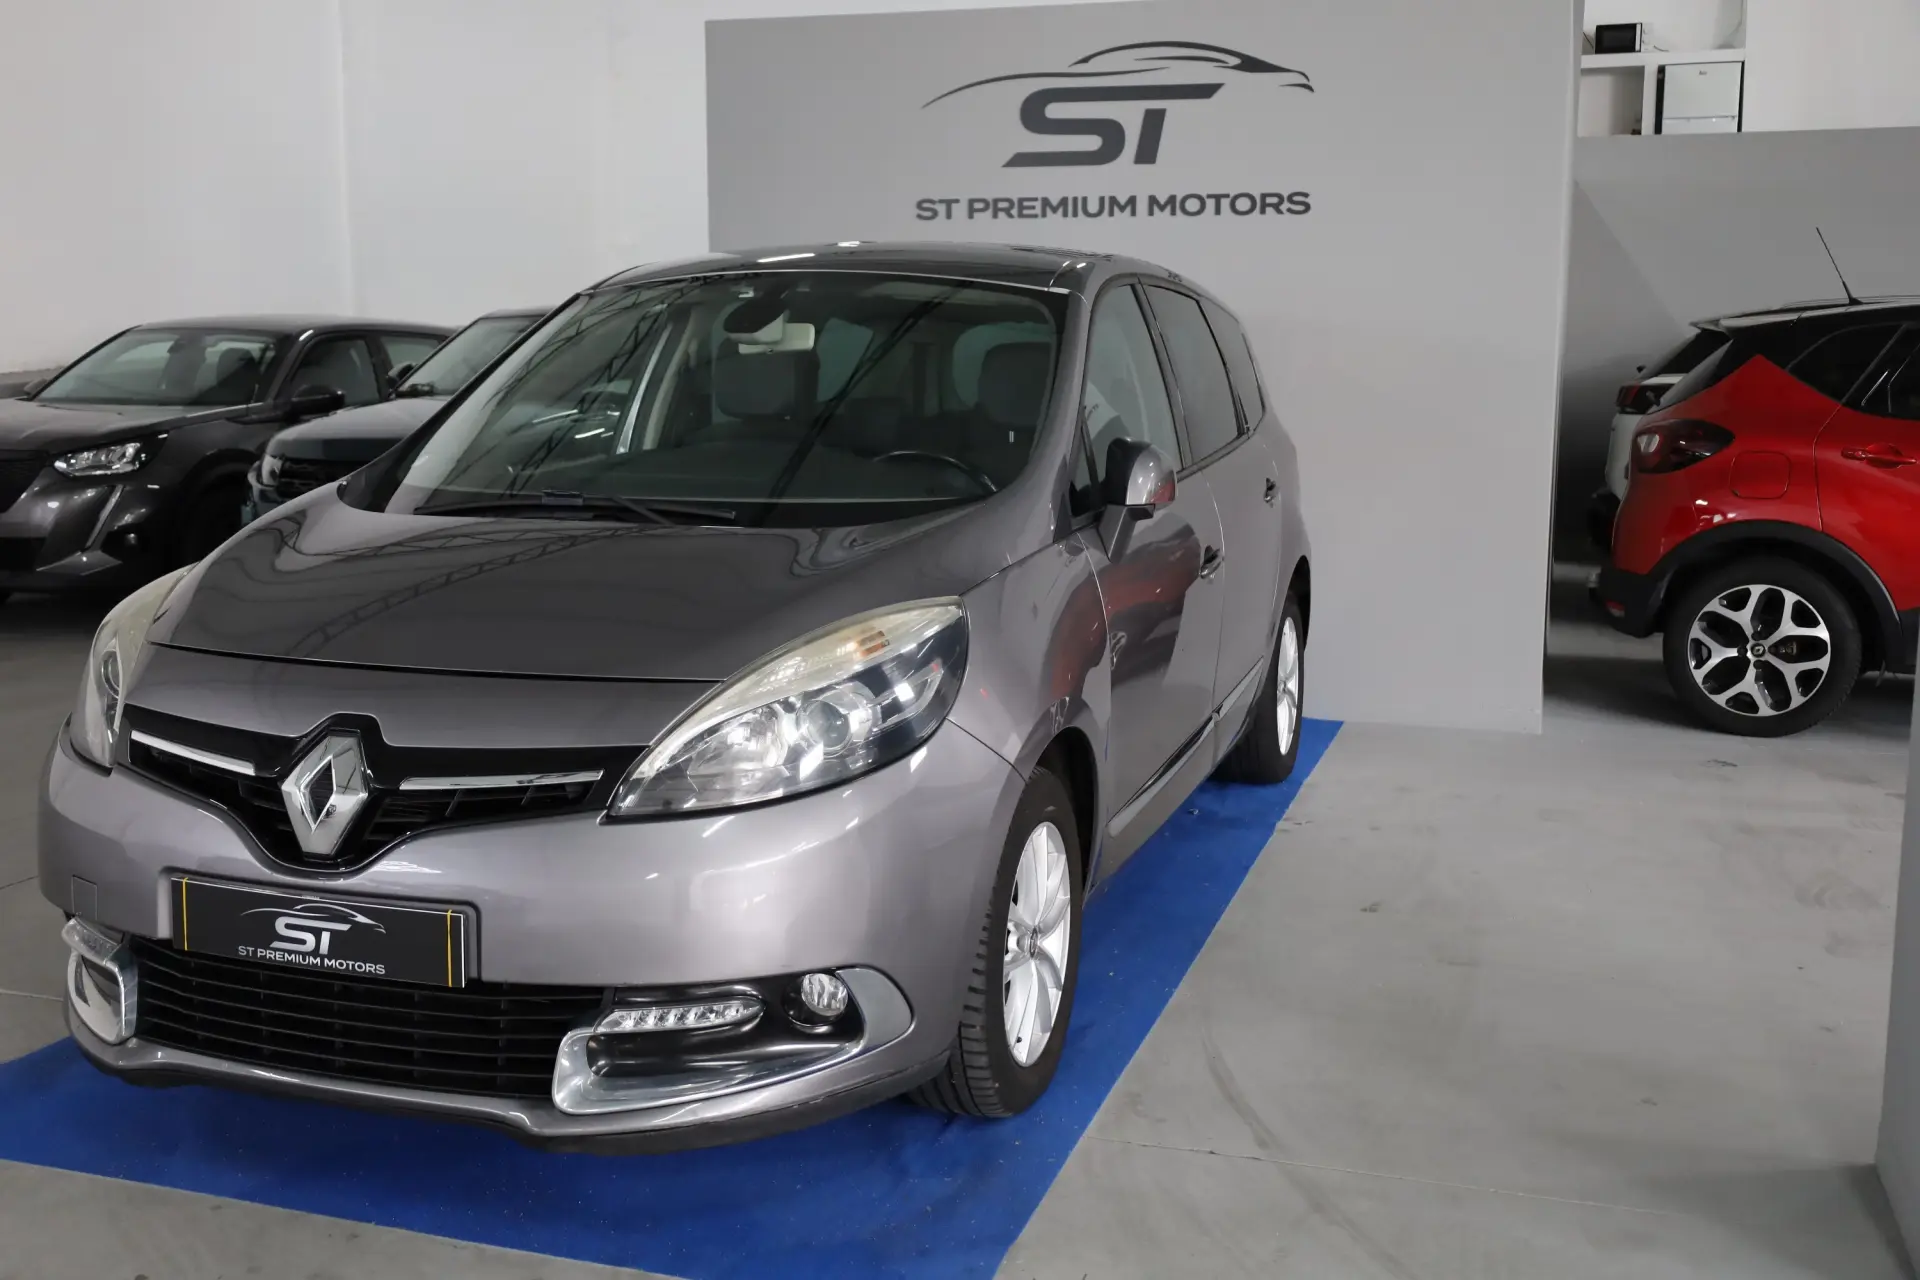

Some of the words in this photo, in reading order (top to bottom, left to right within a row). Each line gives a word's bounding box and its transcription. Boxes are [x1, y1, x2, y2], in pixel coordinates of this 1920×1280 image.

[1001, 83, 1225, 167] ST
[915, 198, 960, 221] ST
[967, 195, 1138, 219] PREMIUM
[1147, 191, 1312, 217] MOTORS
[270, 916, 352, 954] ST
[238, 945, 255, 957] ST
[257, 948, 320, 966] PREMIUM
[324, 957, 386, 975] MOTORS
